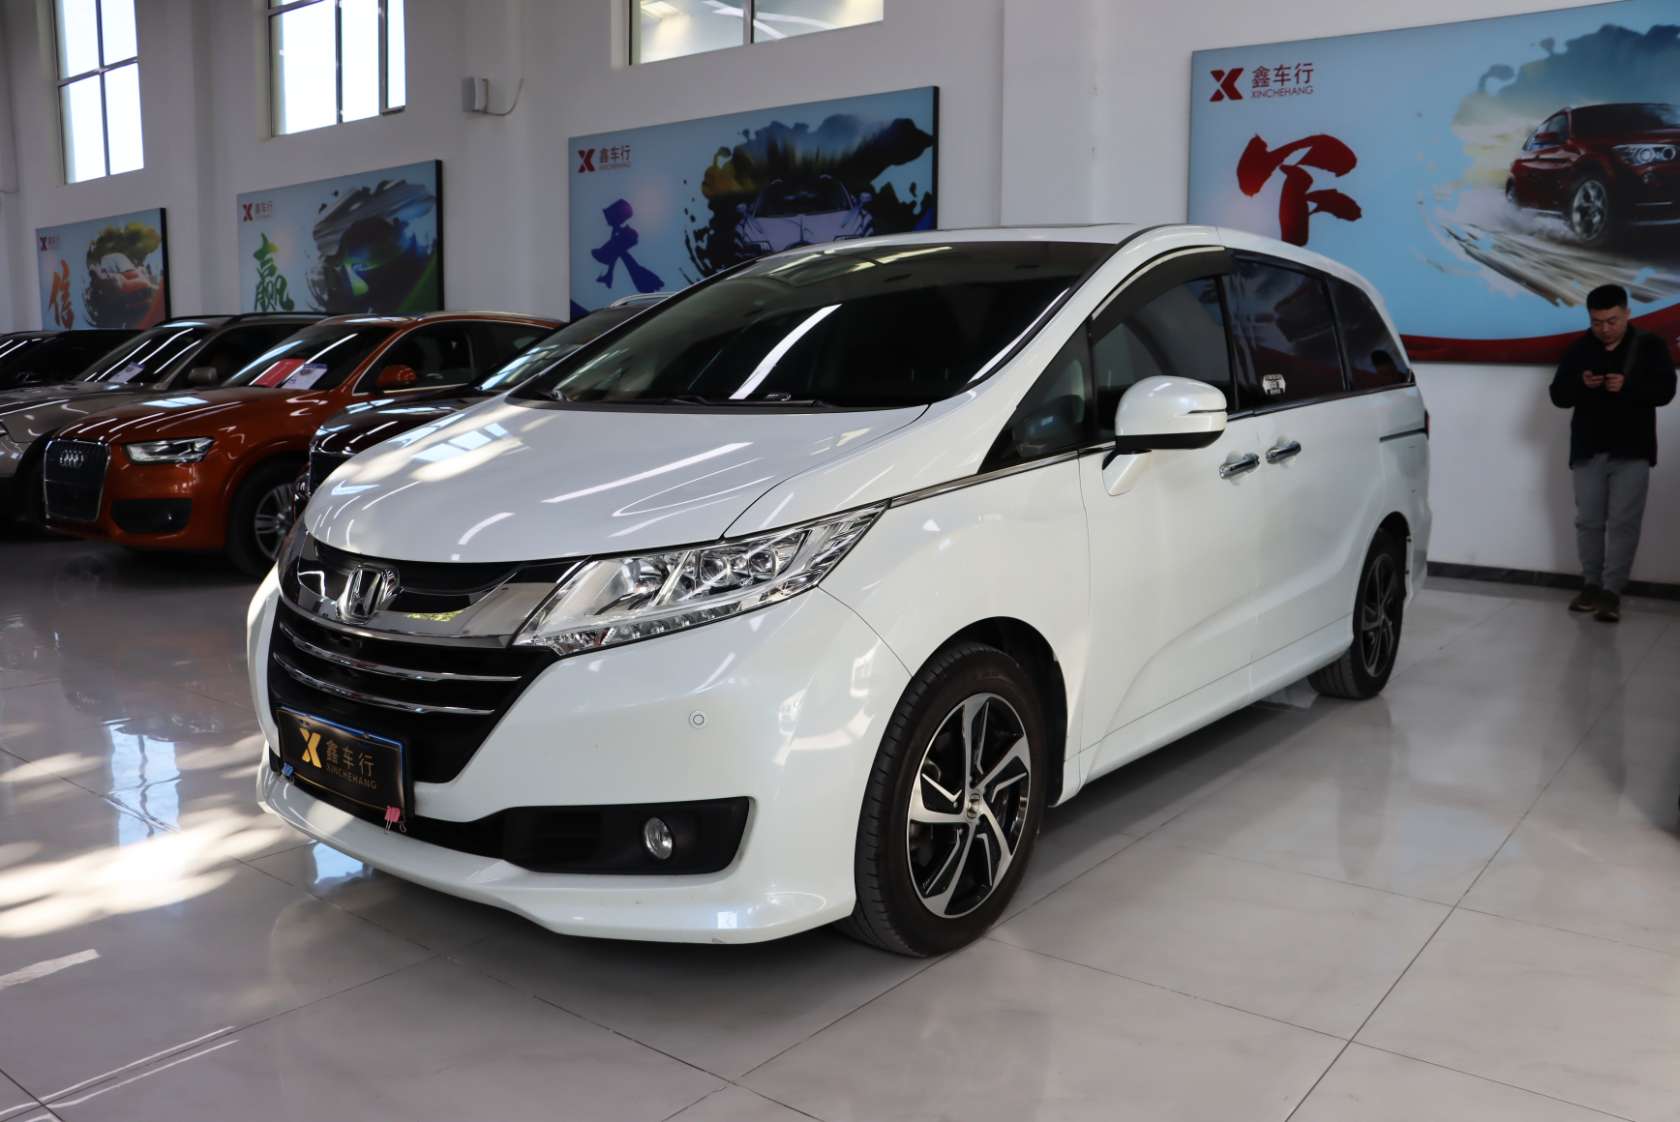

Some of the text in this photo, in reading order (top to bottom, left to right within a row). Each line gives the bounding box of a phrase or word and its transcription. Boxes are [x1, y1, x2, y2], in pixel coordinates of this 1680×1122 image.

[1251, 62, 1313, 89] 鑫车行
[1251, 85, 1314, 99] XINCHEHANG
[591, 198, 665, 294] 天
[326, 739, 375, 778] 鑫车行
